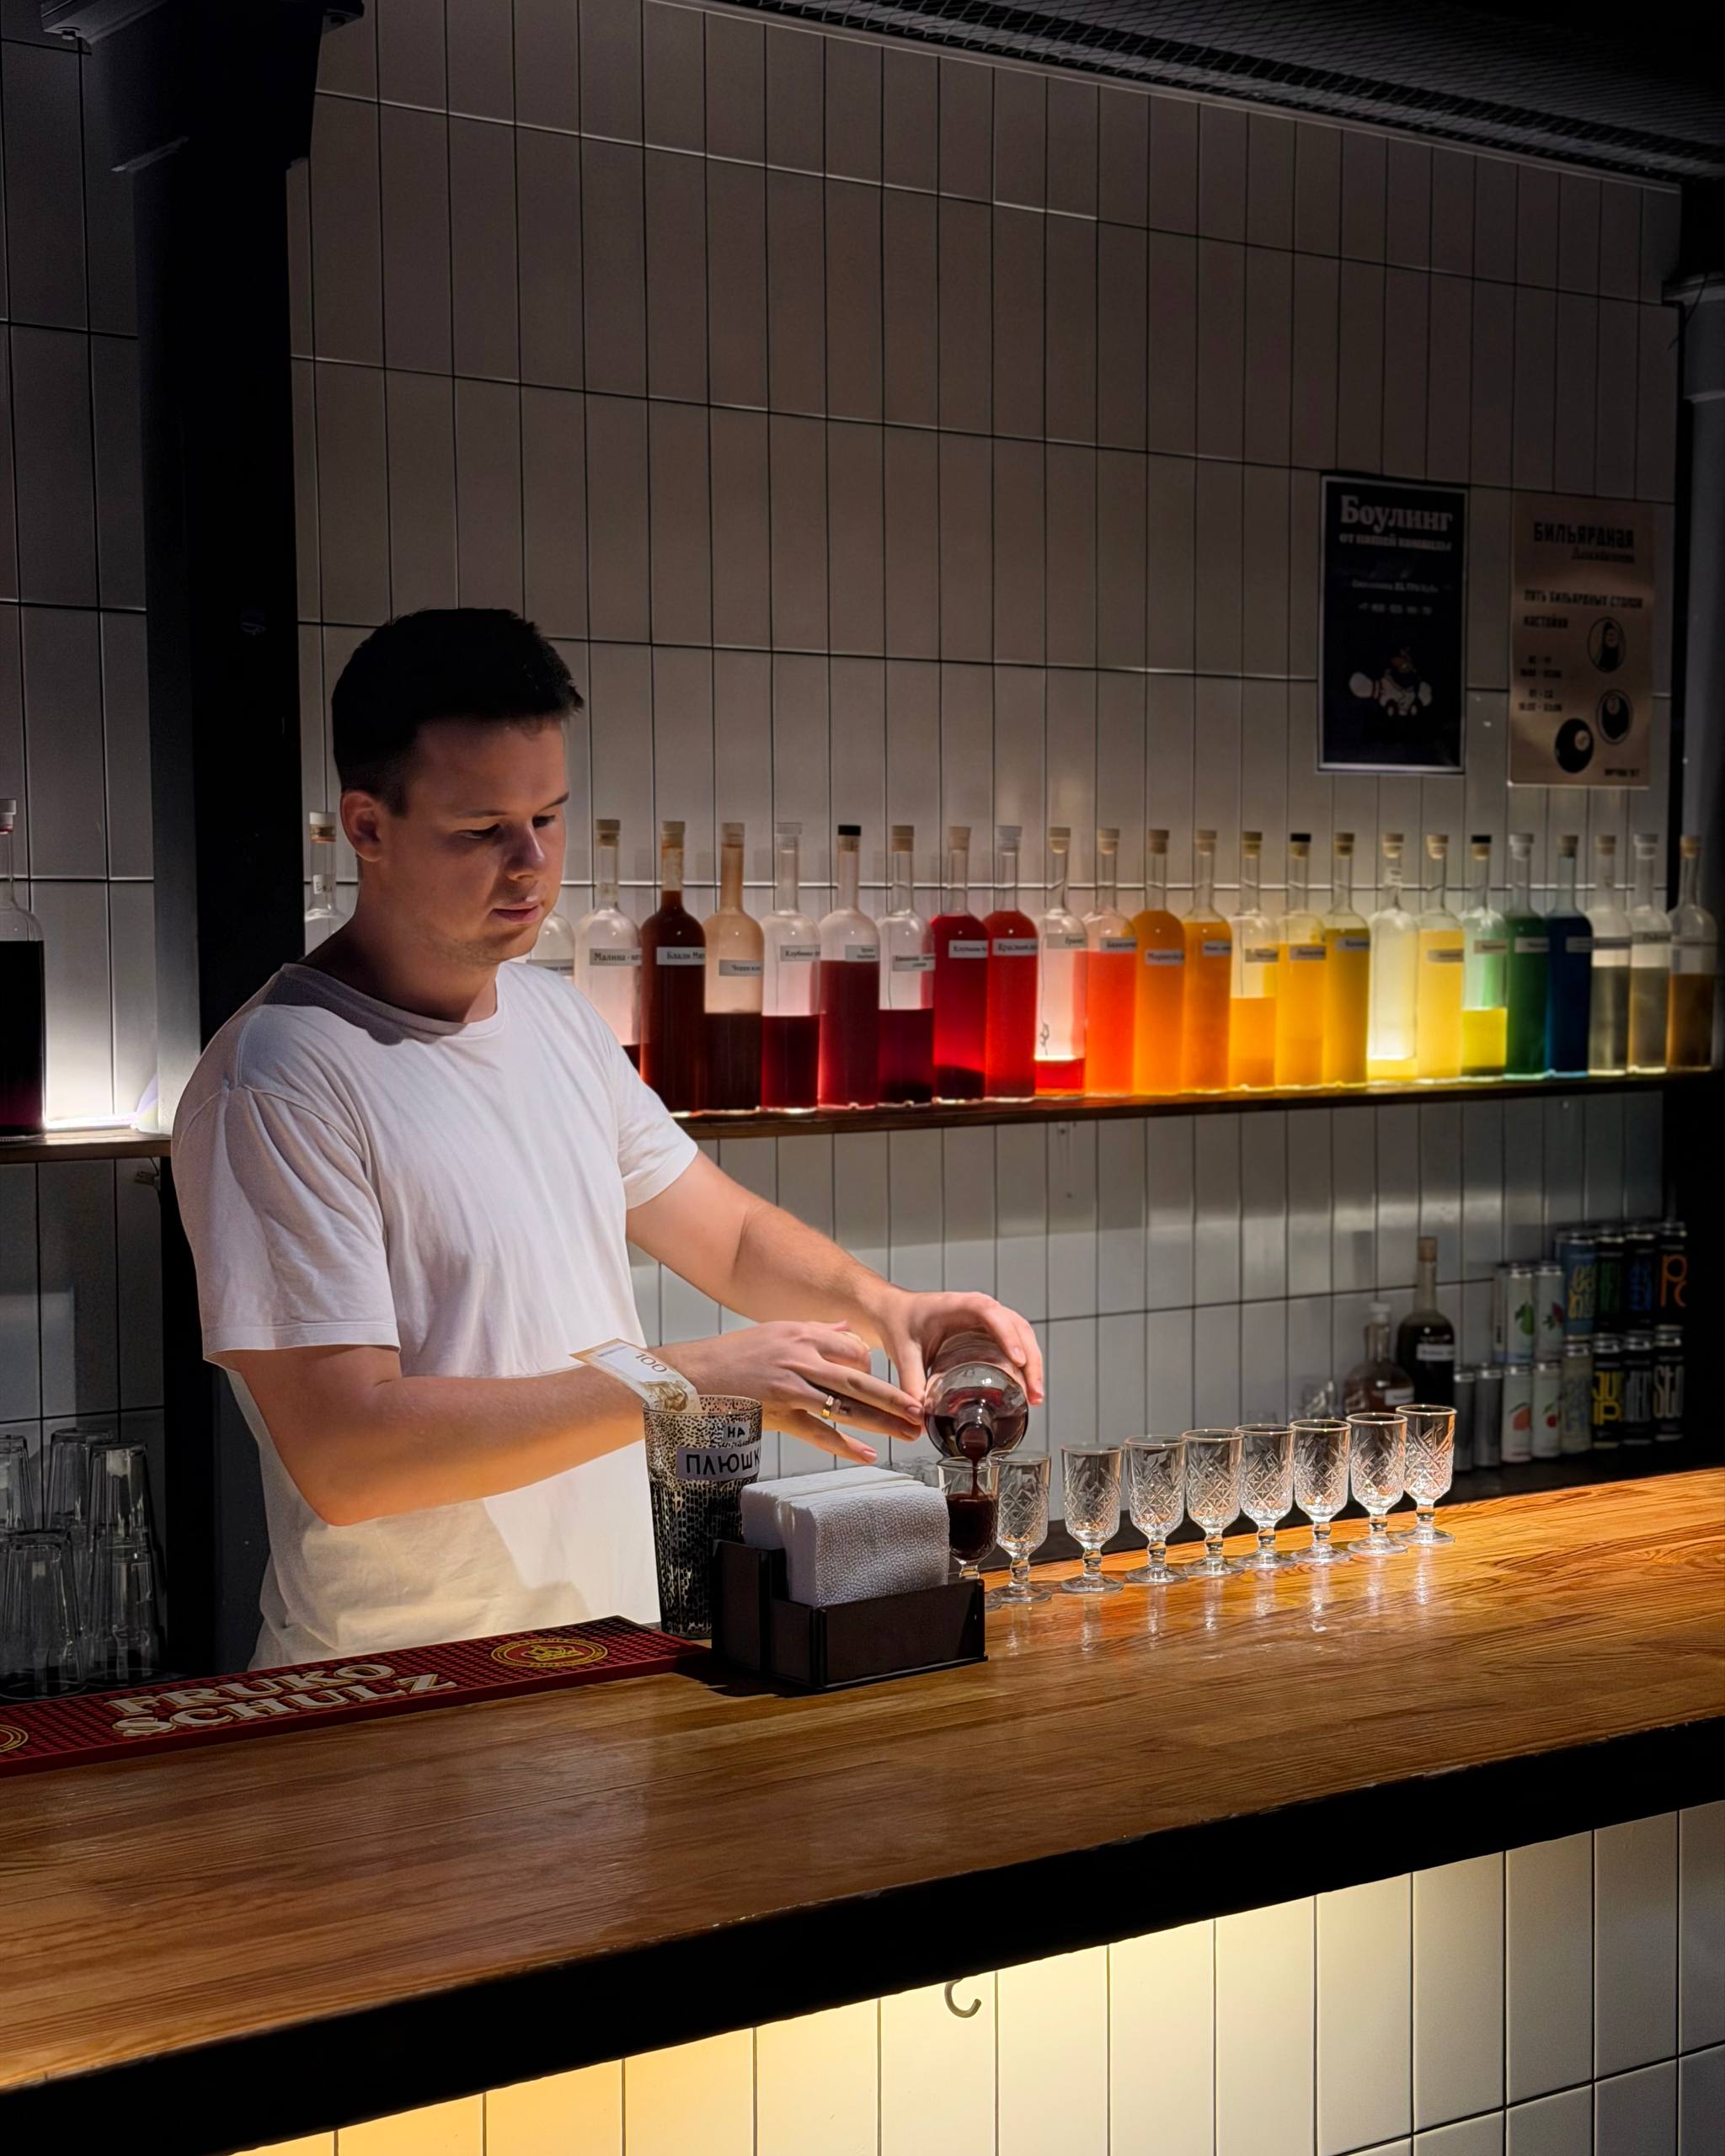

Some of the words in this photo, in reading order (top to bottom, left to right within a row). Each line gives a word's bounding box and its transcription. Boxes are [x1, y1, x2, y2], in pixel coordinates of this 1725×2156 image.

[1340, 494, 1454, 533] Боулинг
[1534, 522, 1634, 548] БИЛЬЯРДНАЯ
[593, 953, 626, 962] Малина
[635, 1353, 667, 1374] 100
[727, 1426, 745, 1438] НА
[686, 1447, 761, 1476] ПЛЮШК
[104, 1663, 396, 1716] FRUKO
[112, 1674, 457, 1737] SCHULZ
